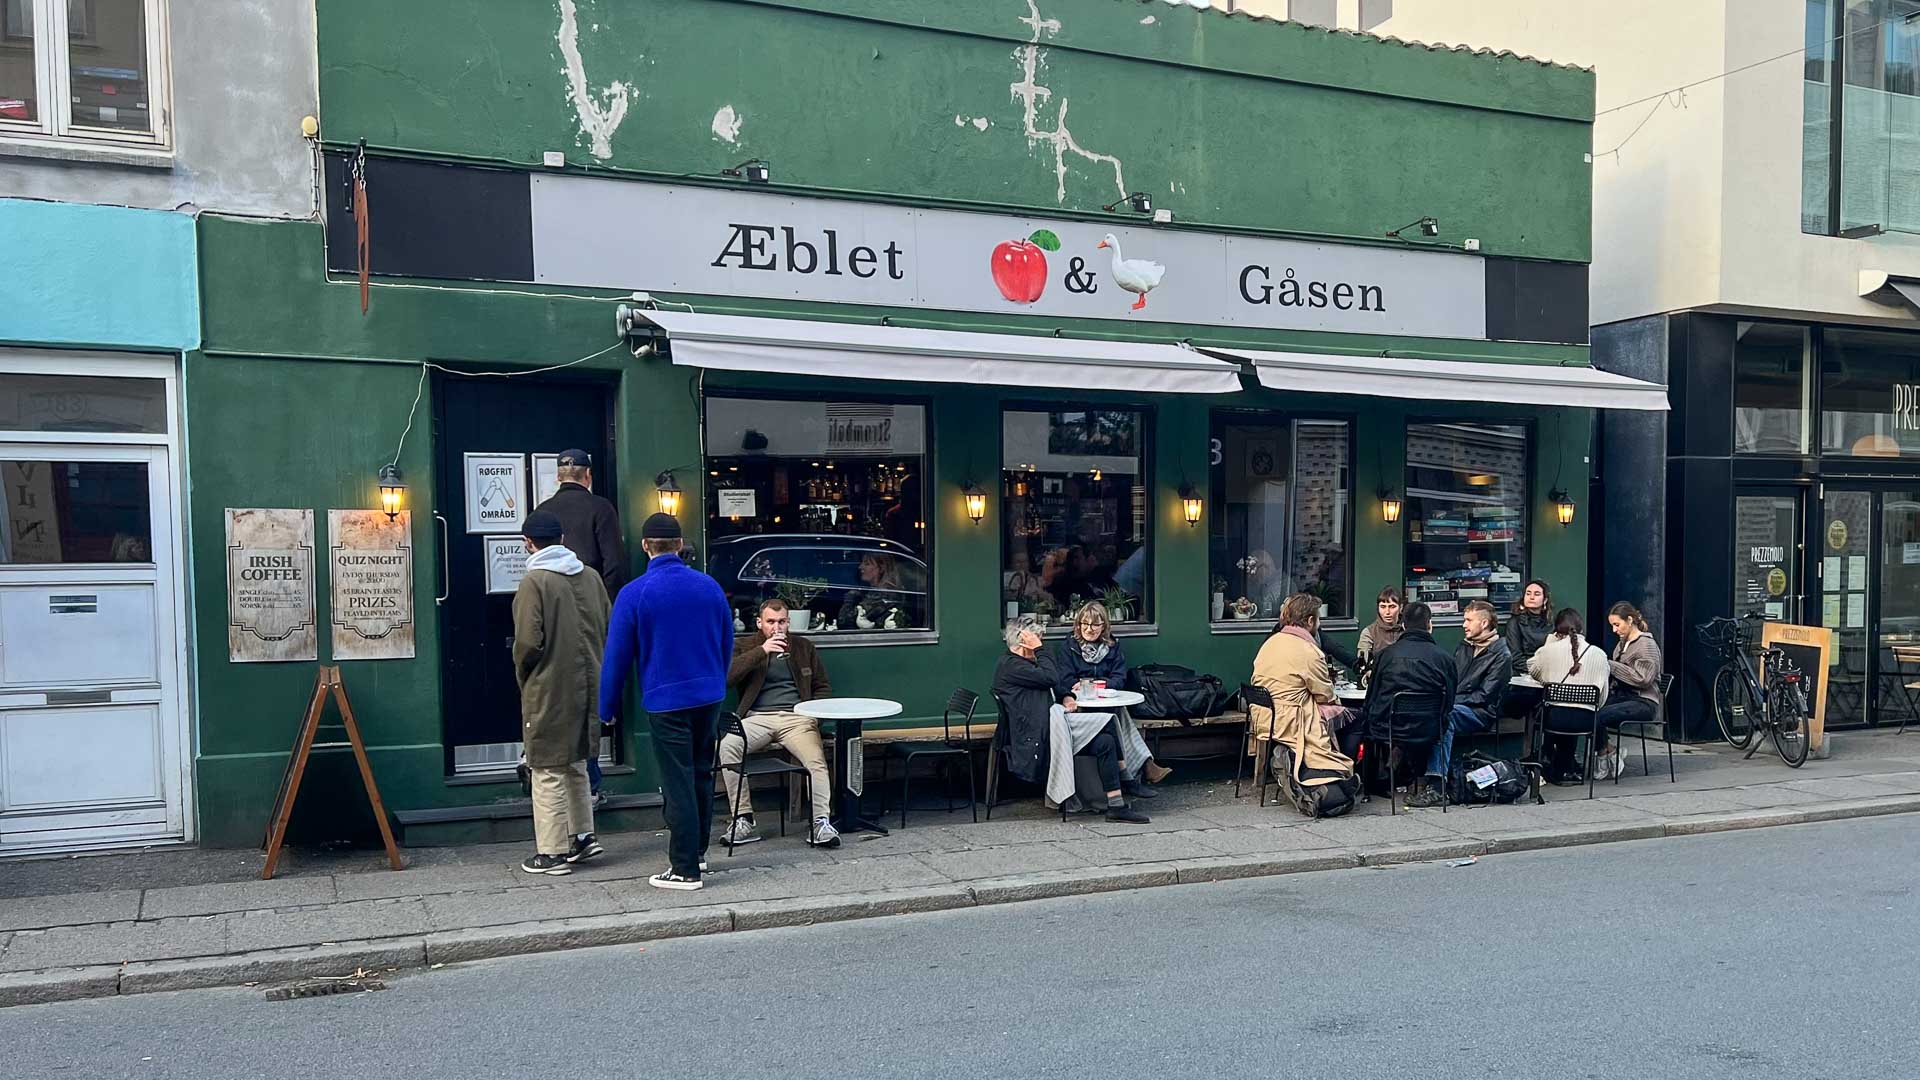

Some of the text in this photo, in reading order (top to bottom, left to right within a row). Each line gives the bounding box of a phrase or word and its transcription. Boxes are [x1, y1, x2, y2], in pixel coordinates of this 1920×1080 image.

[711, 222, 1387, 313] Æblet & Gåsen
[479, 467, 513, 476] RØGFRIT
[481, 509, 516, 519] OMRÅDE
[496, 545, 521, 556] QUIZ
[249, 556, 292, 568] IRISH
[338, 555, 405, 567] QUIZ NIGHT
[241, 569, 302, 581] COFFEE
[349, 597, 396, 608] PRIZES
